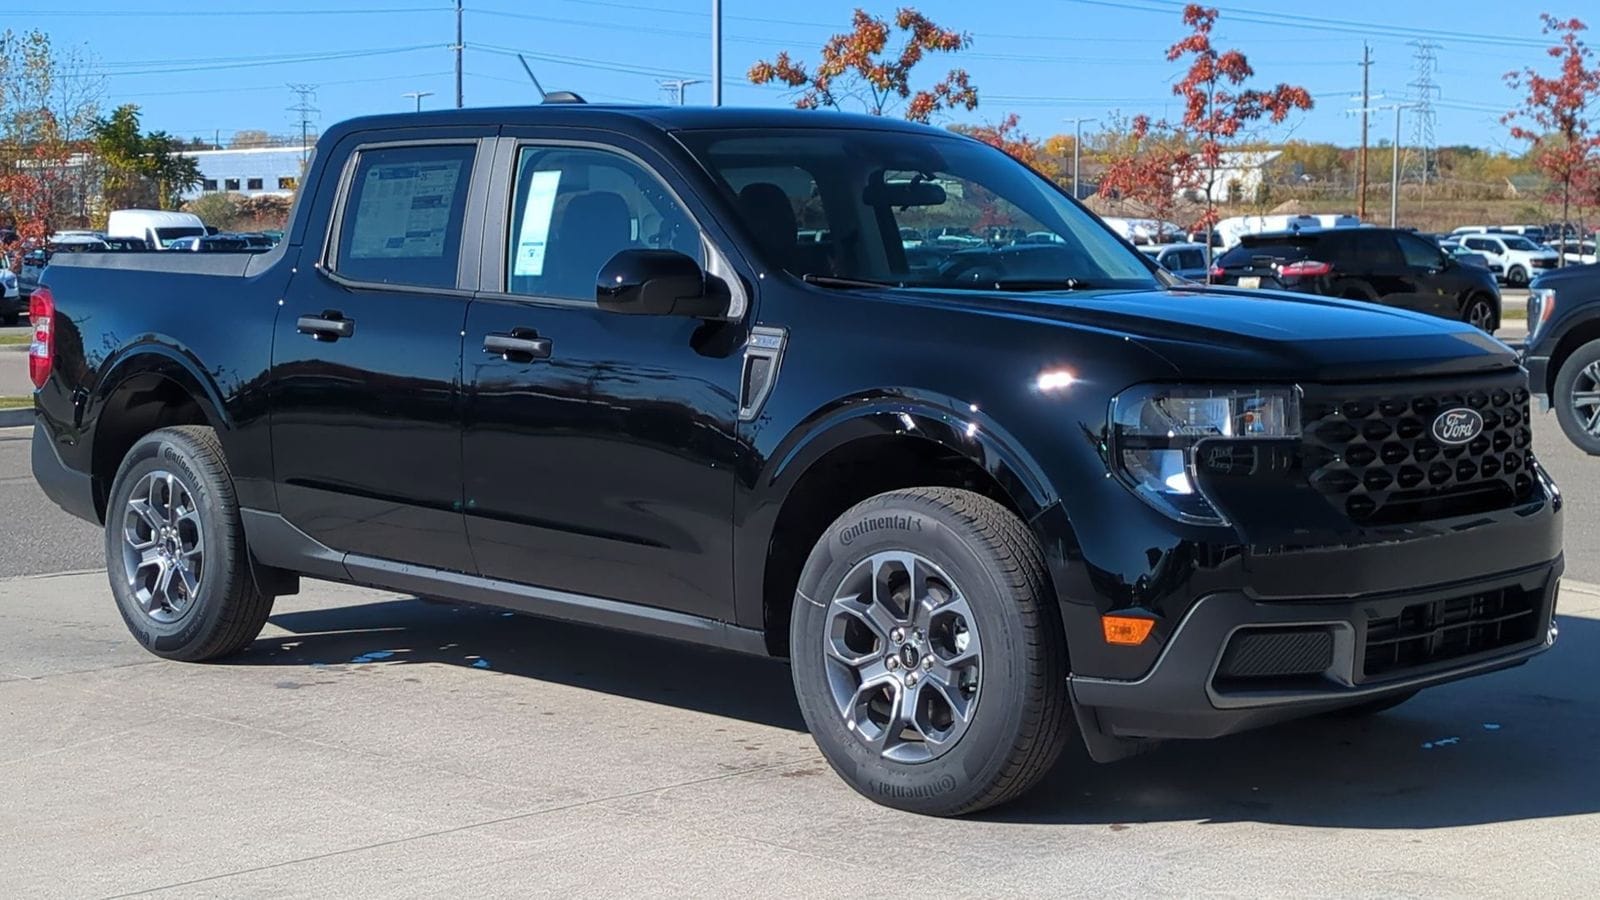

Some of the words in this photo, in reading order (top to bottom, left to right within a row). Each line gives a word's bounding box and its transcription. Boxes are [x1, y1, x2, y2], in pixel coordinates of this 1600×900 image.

[1443, 413, 1474, 438] Ford
[840, 515, 912, 545] Continental
[880, 774, 956, 799] Continental
